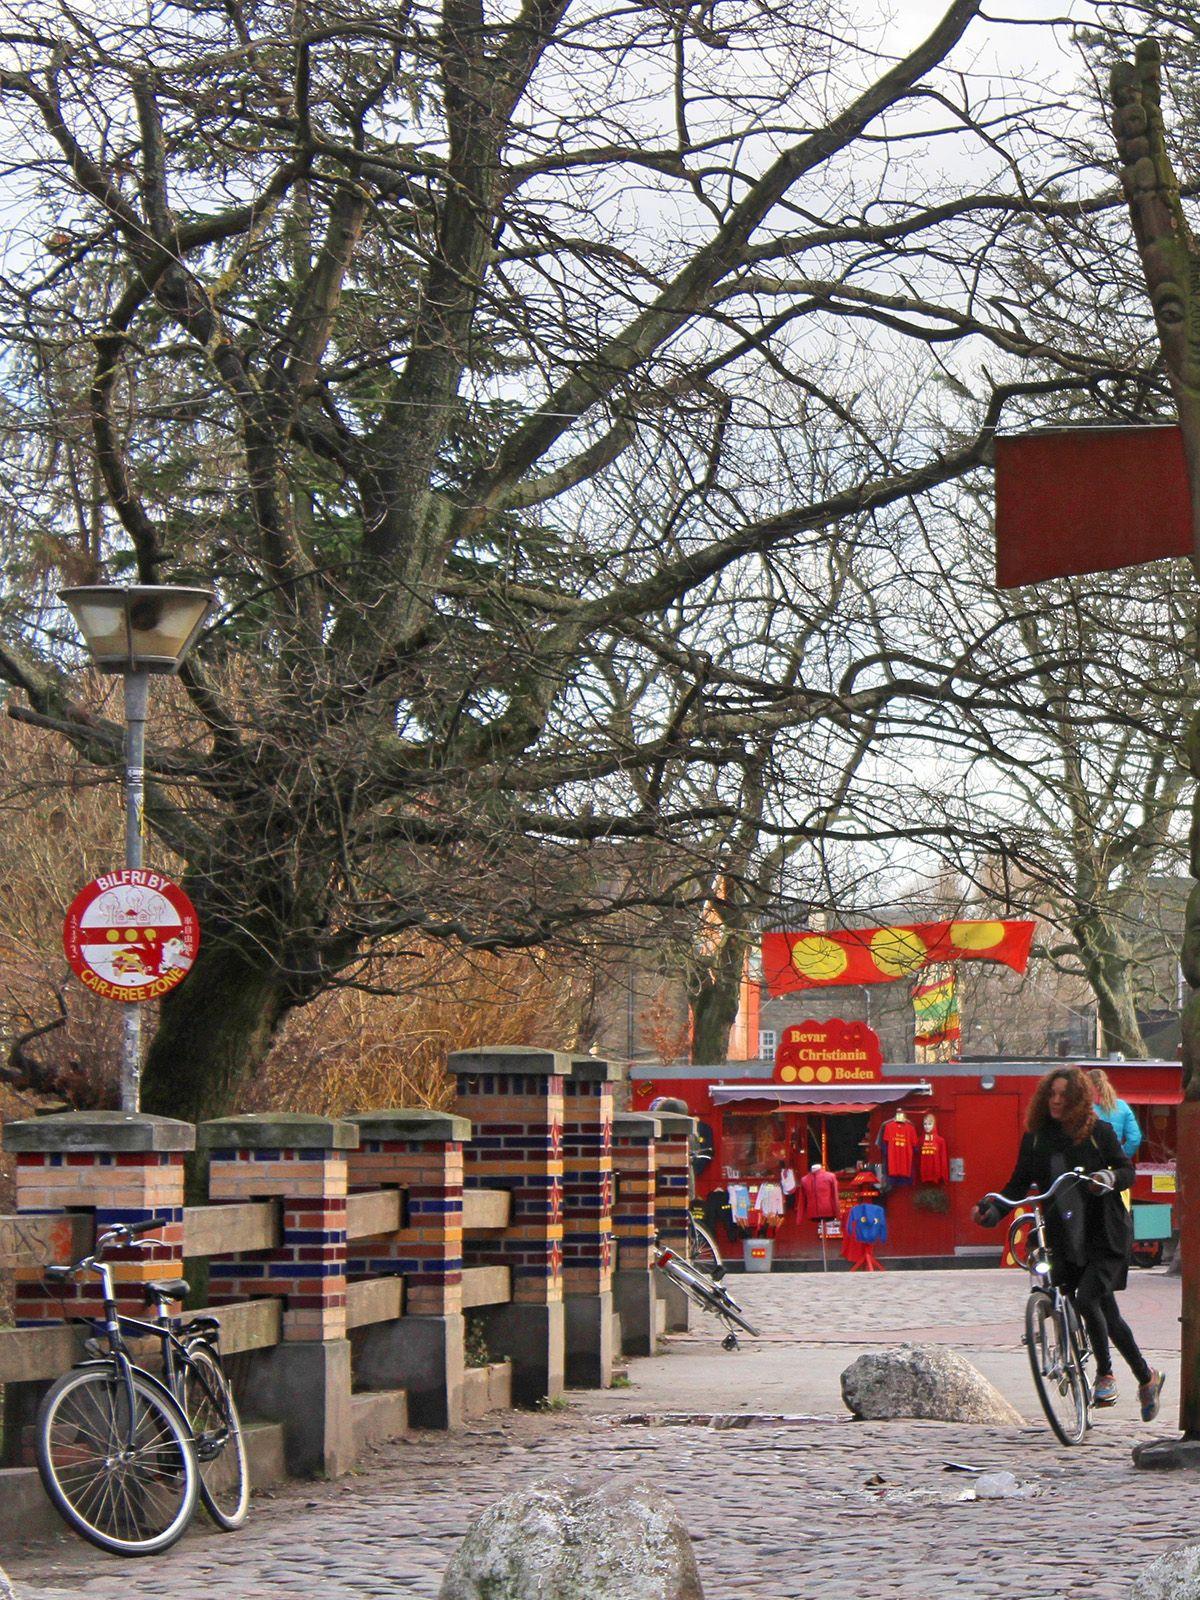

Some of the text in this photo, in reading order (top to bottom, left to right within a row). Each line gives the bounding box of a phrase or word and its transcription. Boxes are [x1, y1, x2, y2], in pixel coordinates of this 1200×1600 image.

[96, 871, 171, 892] BILFRI BY
[80, 967, 185, 1000] CAR-FREE ZONE
[790, 1030, 827, 1043] Bevar
[799, 1048, 867, 1060] Christiania
[835, 1067, 874, 1079] Boden
